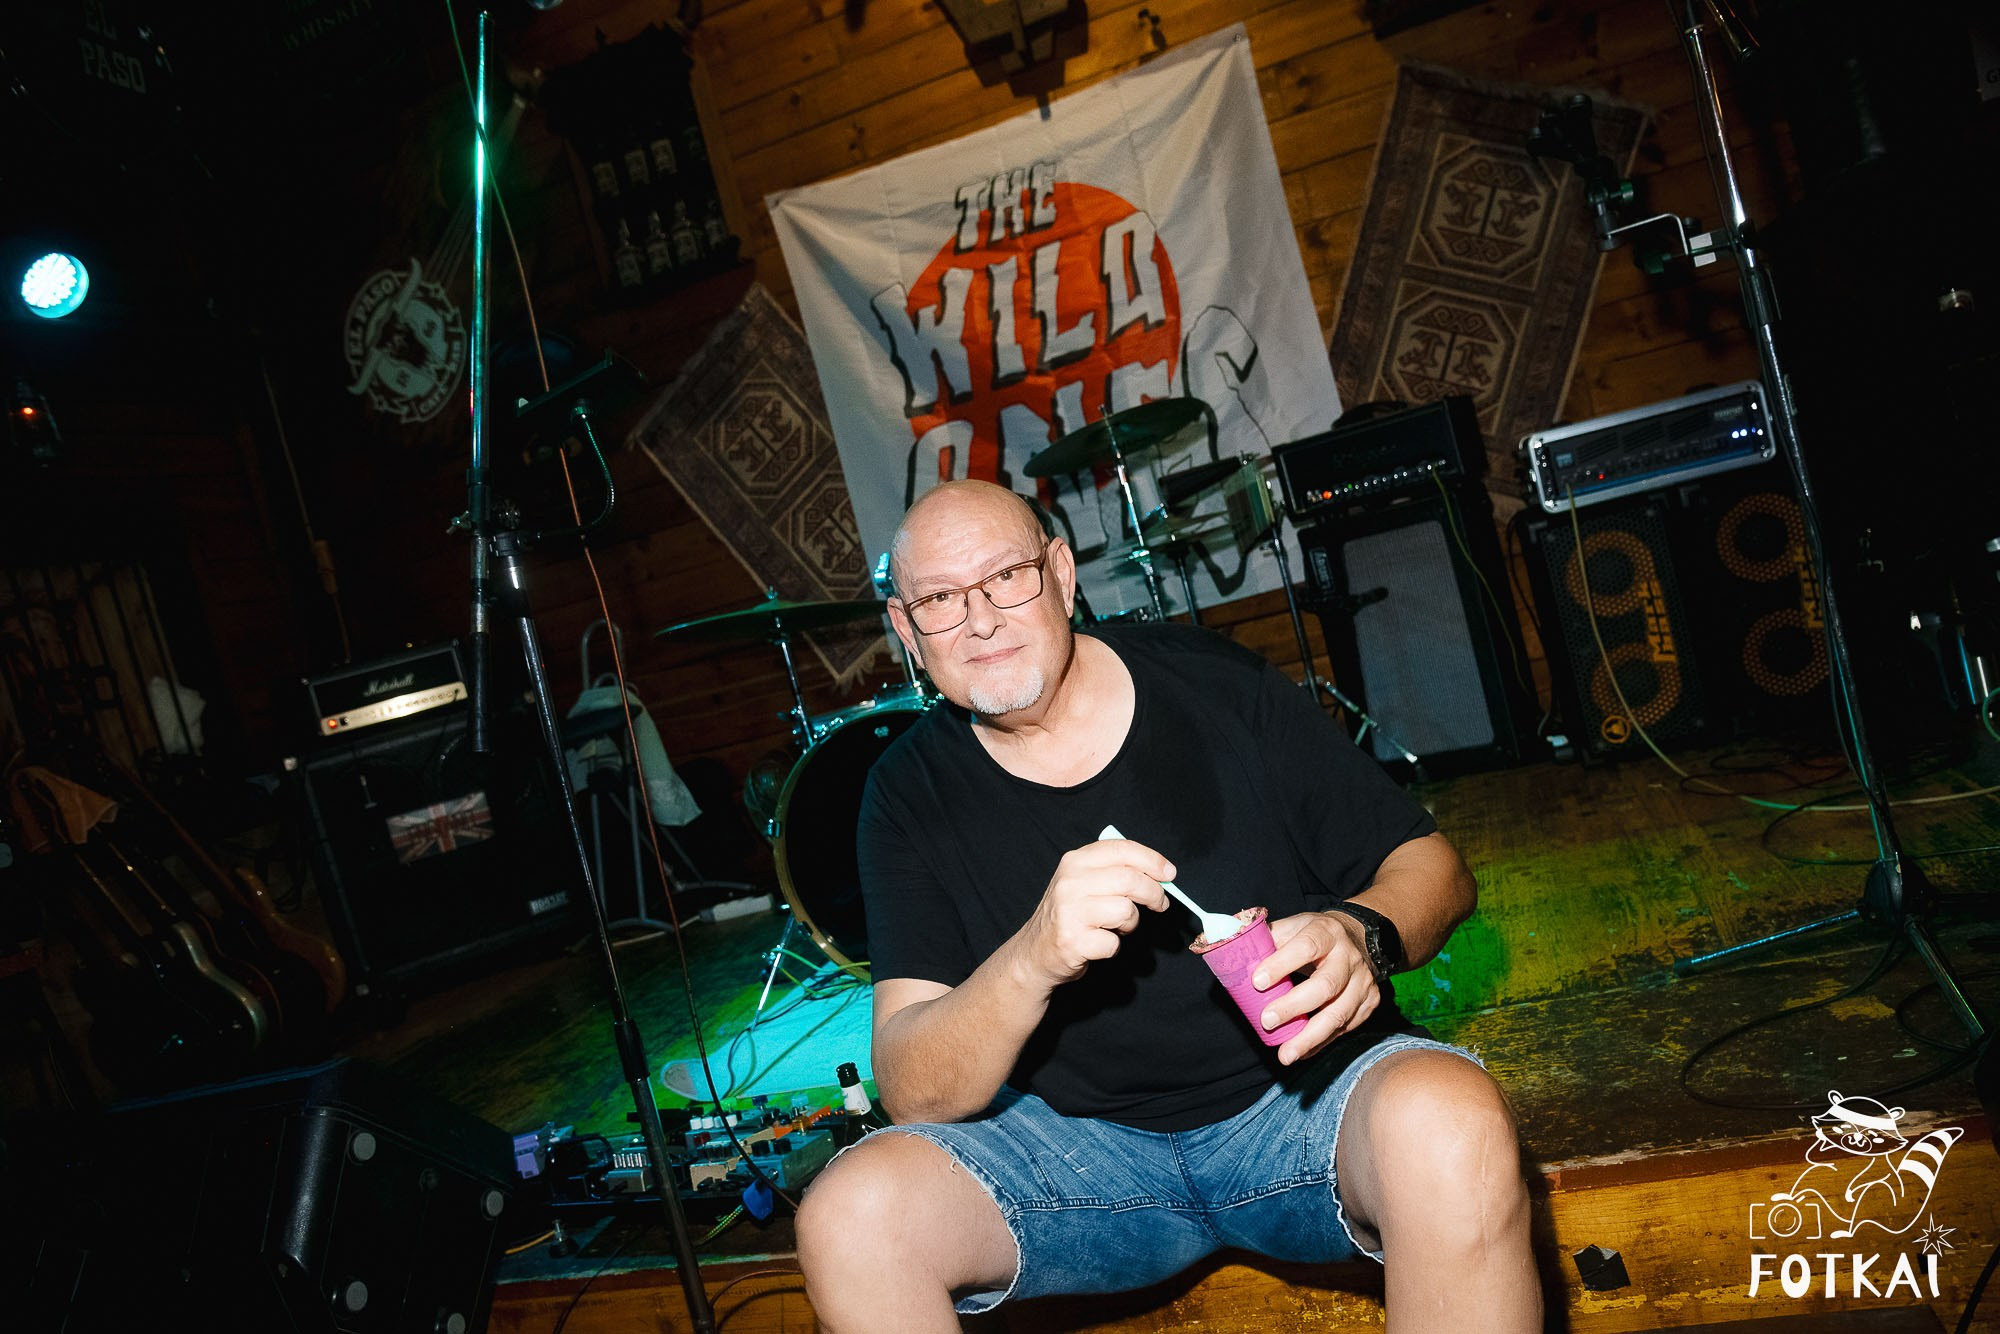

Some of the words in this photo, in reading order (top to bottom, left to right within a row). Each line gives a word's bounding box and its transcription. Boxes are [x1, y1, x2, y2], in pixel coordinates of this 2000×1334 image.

[77, 37, 147, 94] PASO
[954, 161, 1058, 255] THE
[355, 277, 395, 321] PASO
[871, 210, 1169, 418] WILD
[350, 326, 364, 357] EL
[362, 671, 416, 698] Marshall
